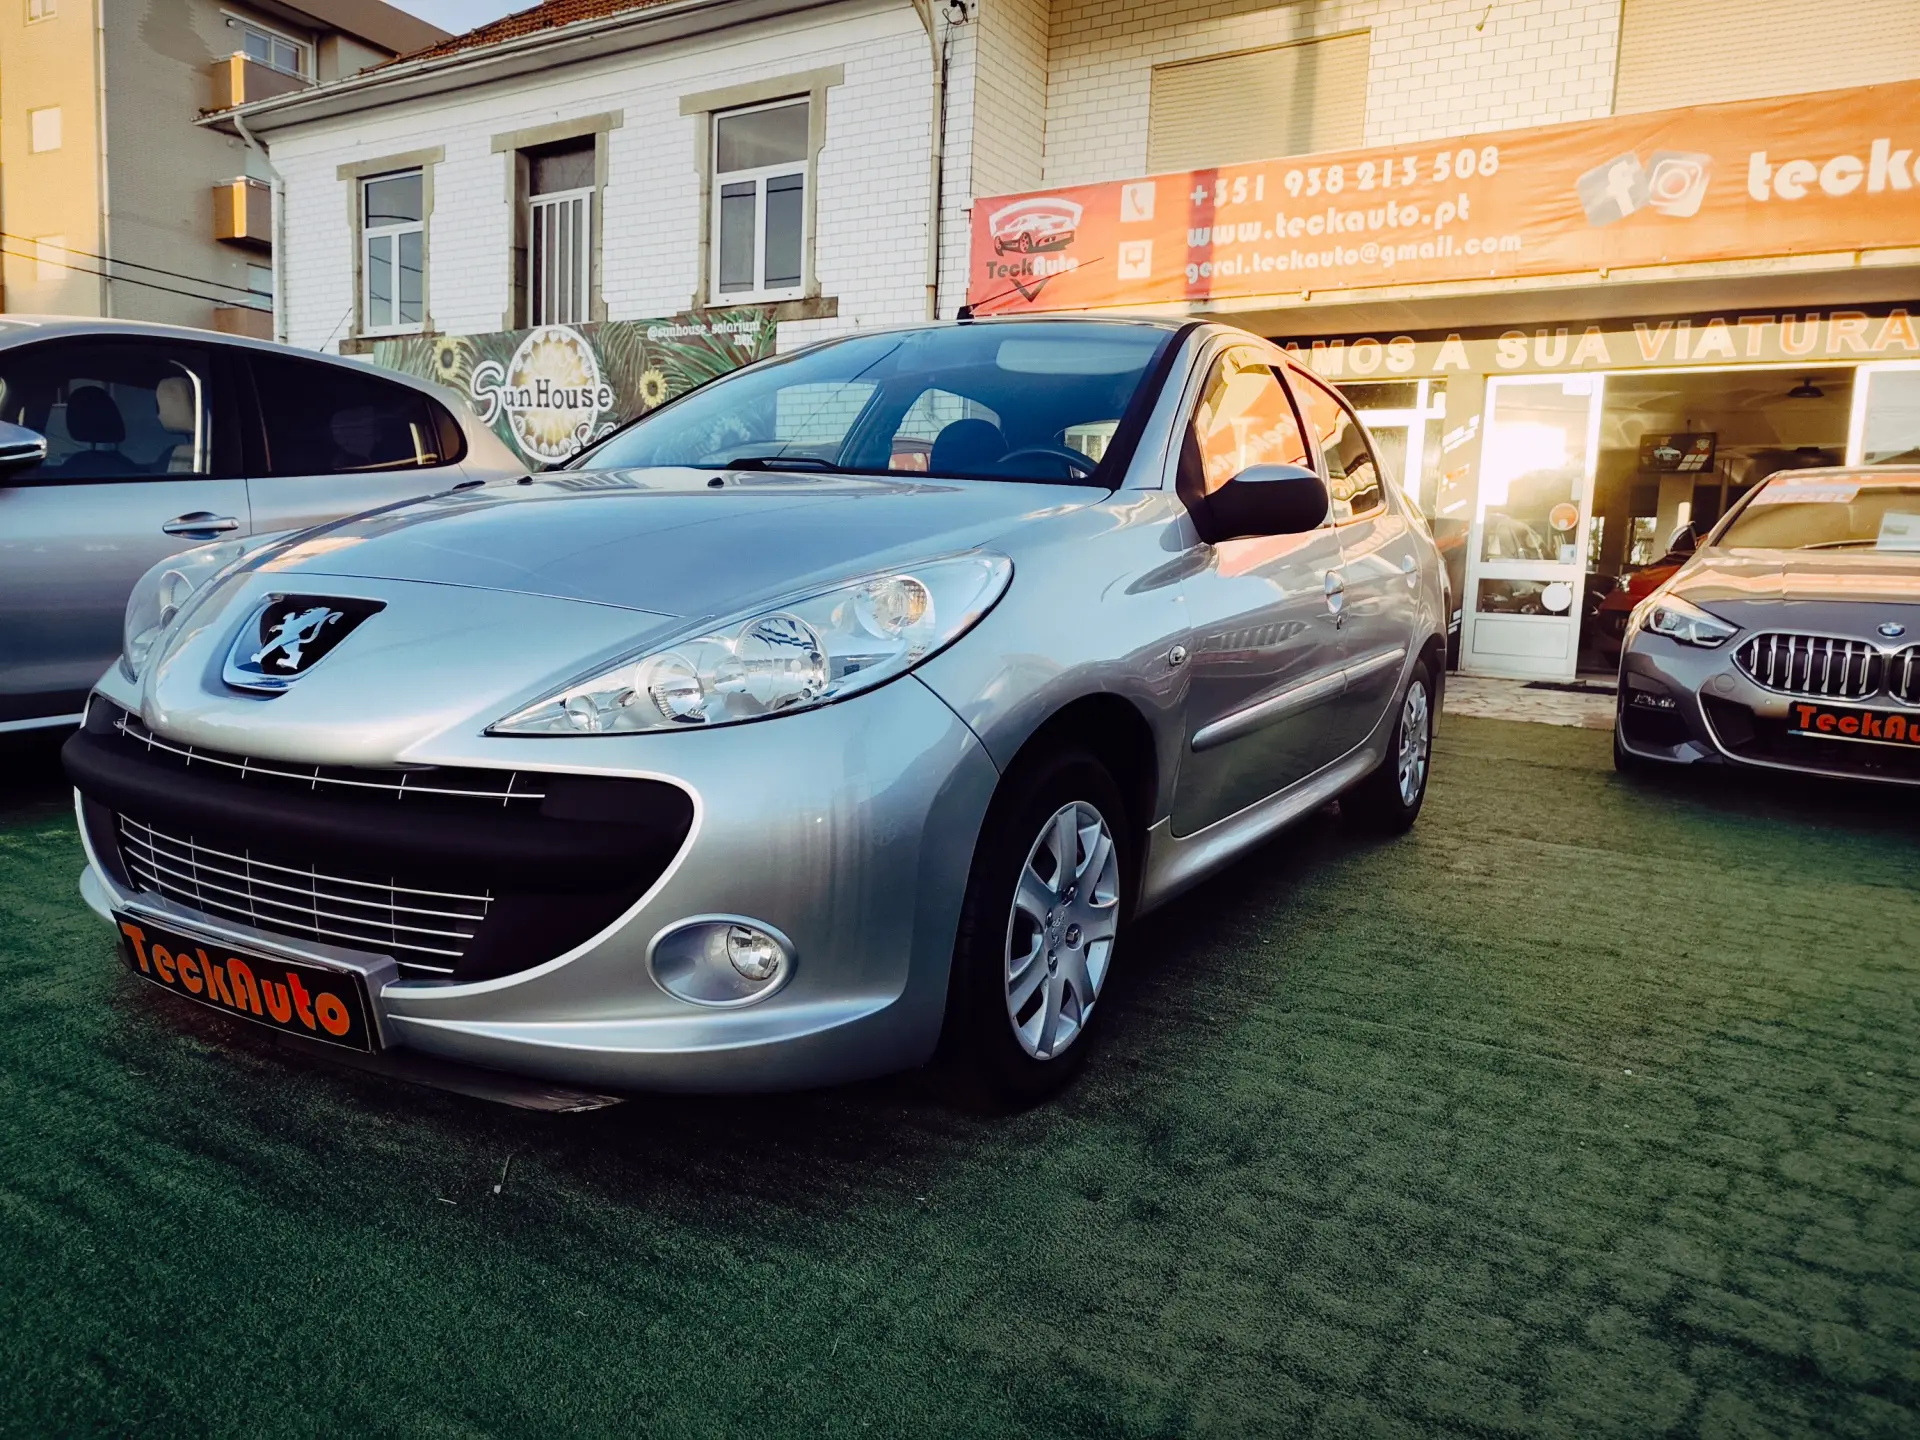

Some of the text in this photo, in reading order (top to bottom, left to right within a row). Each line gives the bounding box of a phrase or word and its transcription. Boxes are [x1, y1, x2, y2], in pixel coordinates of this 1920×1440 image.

[1190, 146, 1499, 208] +351 938 213 508
[1747, 138, 1920, 202] teck
[1187, 192, 1470, 248] www.teckauto.pt
[986, 254, 1080, 279] TeckAuto
[1185, 234, 1522, 284] geral.teckauto@gmail.com
[1432, 333, 1470, 371] A
[1495, 325, 1612, 369] SUA
[1632, 308, 1920, 362] VIATURA
[471, 360, 613, 428] SunHouse
[121, 922, 350, 1036] TeckAuto
